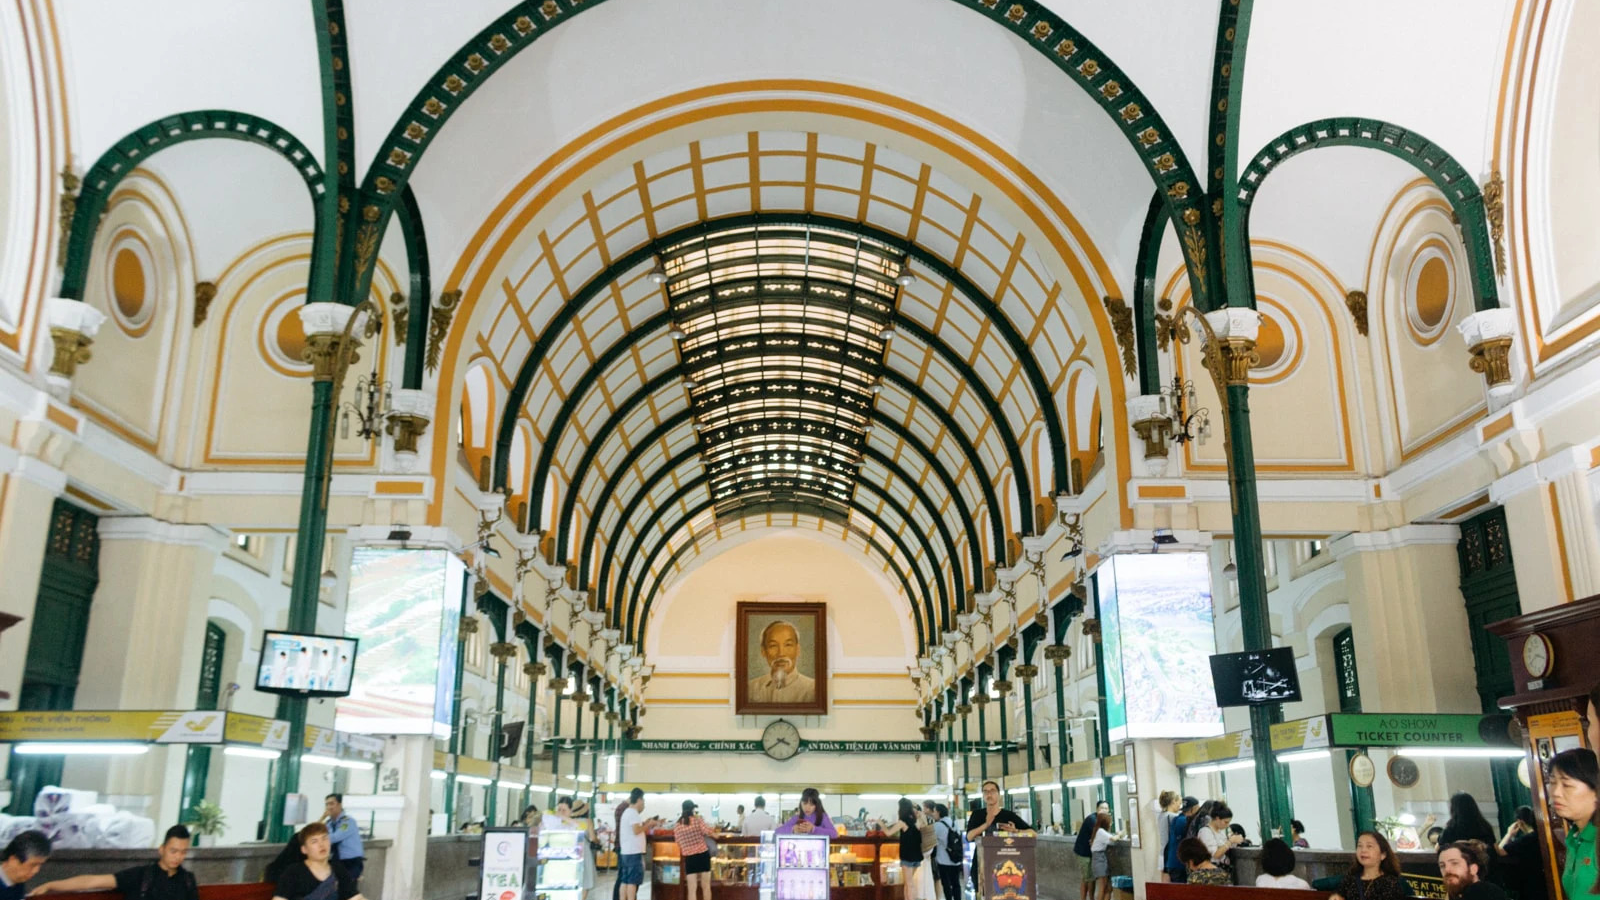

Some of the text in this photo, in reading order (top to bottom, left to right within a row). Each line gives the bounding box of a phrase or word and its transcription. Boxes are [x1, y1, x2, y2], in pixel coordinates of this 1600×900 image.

[1401, 719, 1437, 730] SHOW
[1356, 731, 1464, 743] TICKET COUNTER
[642, 742, 669, 750] NHANH
[709, 740, 735, 750] CHÍNH
[739, 740, 756, 750] XÁC
[819, 741, 840, 750] TOÀN
[486, 873, 520, 887] TEA
[1421, 882, 1430, 891] AT
